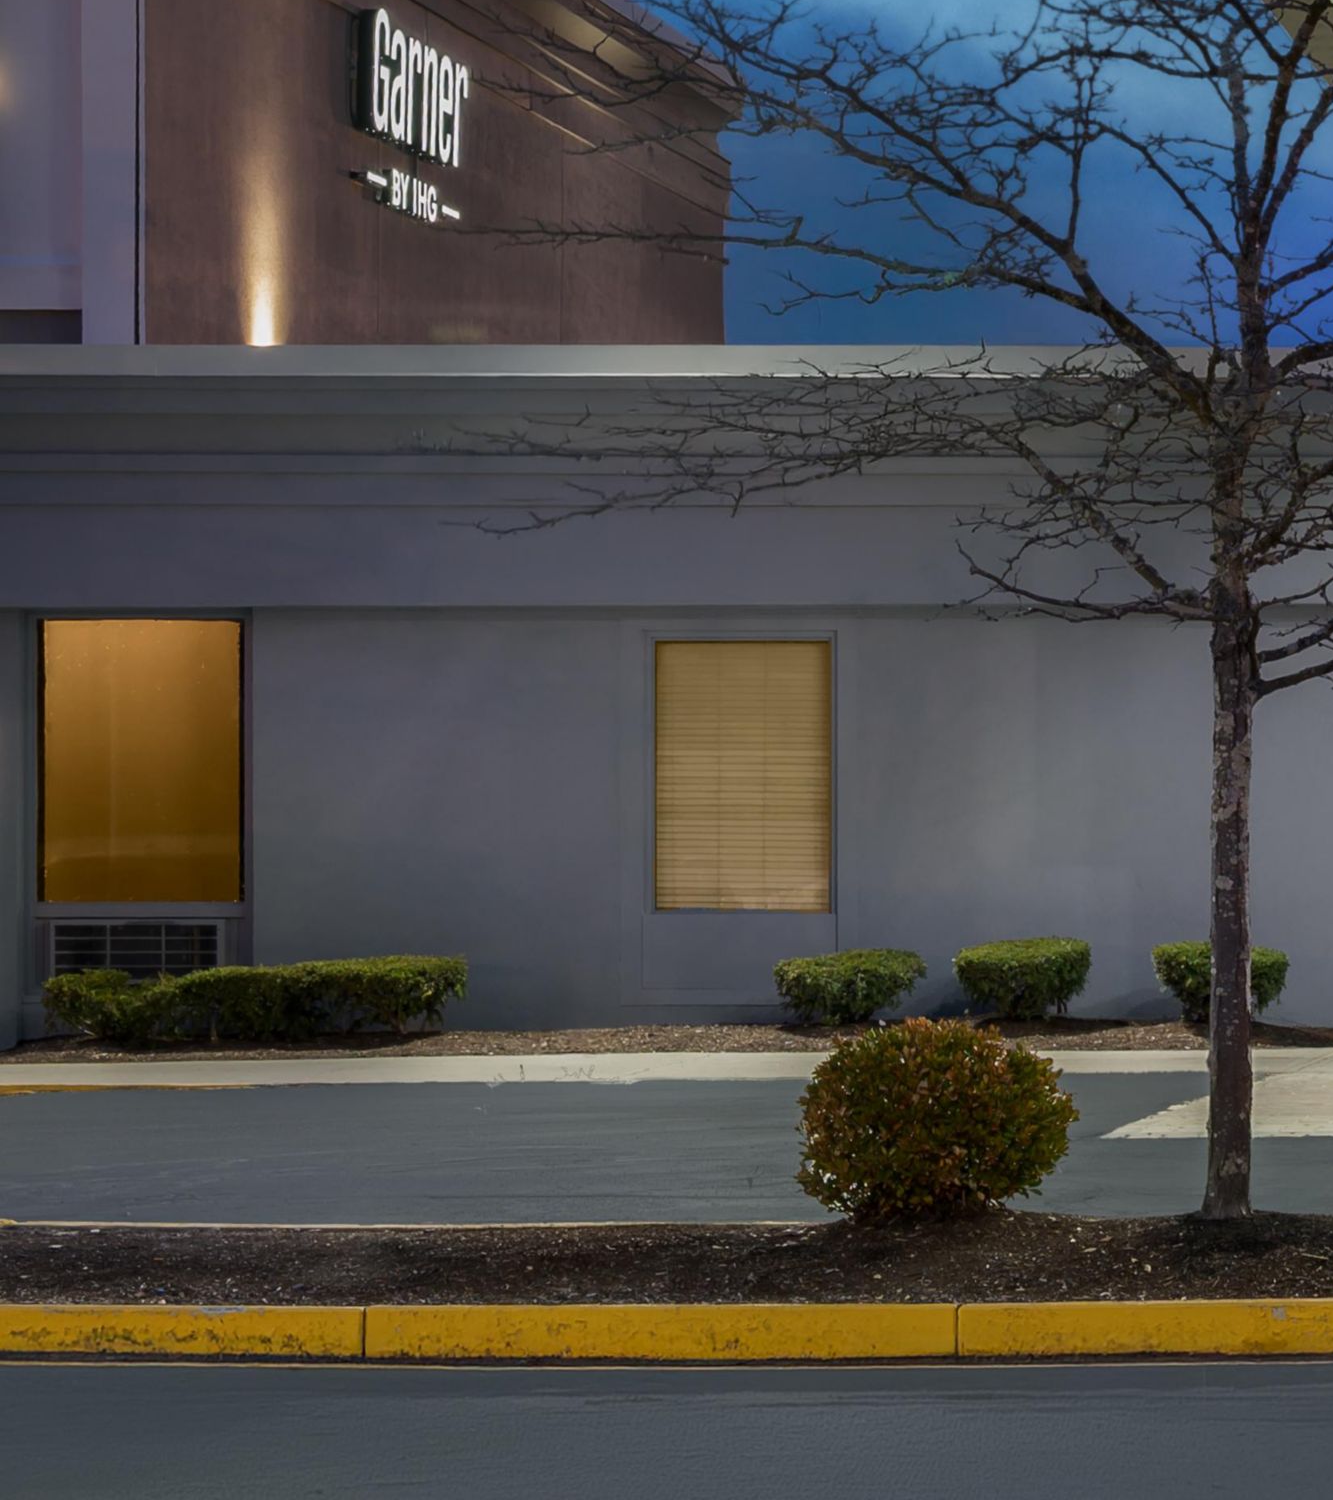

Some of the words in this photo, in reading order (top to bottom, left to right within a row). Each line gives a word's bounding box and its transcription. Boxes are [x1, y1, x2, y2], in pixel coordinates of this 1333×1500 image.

[372, 8, 469, 168] Garner
[392, 168, 409, 210] BY
[412, 178, 437, 223] IHG
